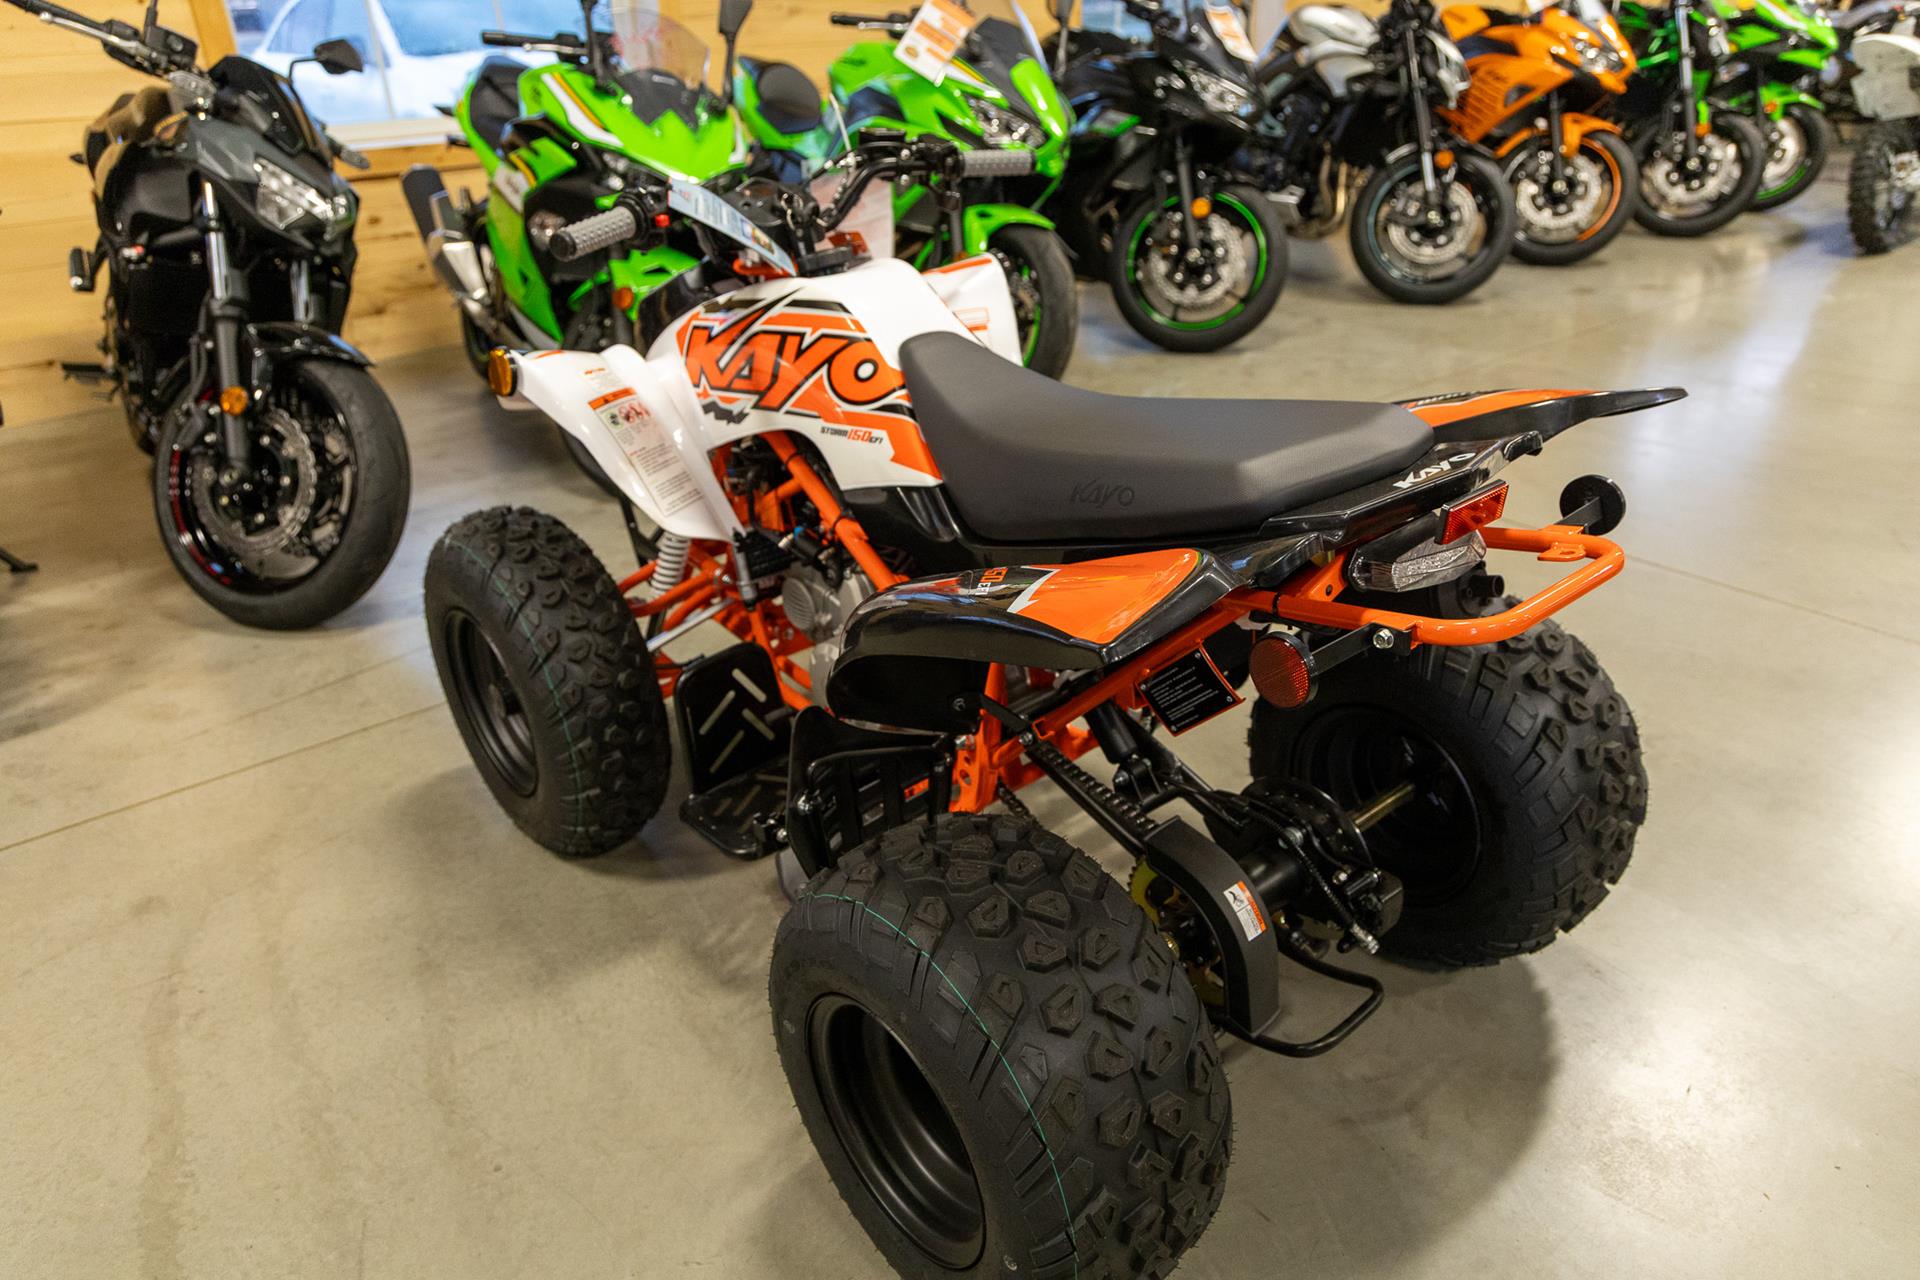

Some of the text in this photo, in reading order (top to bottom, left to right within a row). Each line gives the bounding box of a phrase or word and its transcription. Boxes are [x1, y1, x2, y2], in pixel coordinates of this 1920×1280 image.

[684, 286, 906, 412] KAYO
[1392, 452, 1476, 489] KAYO
[1070, 477, 1135, 508] KAYO
